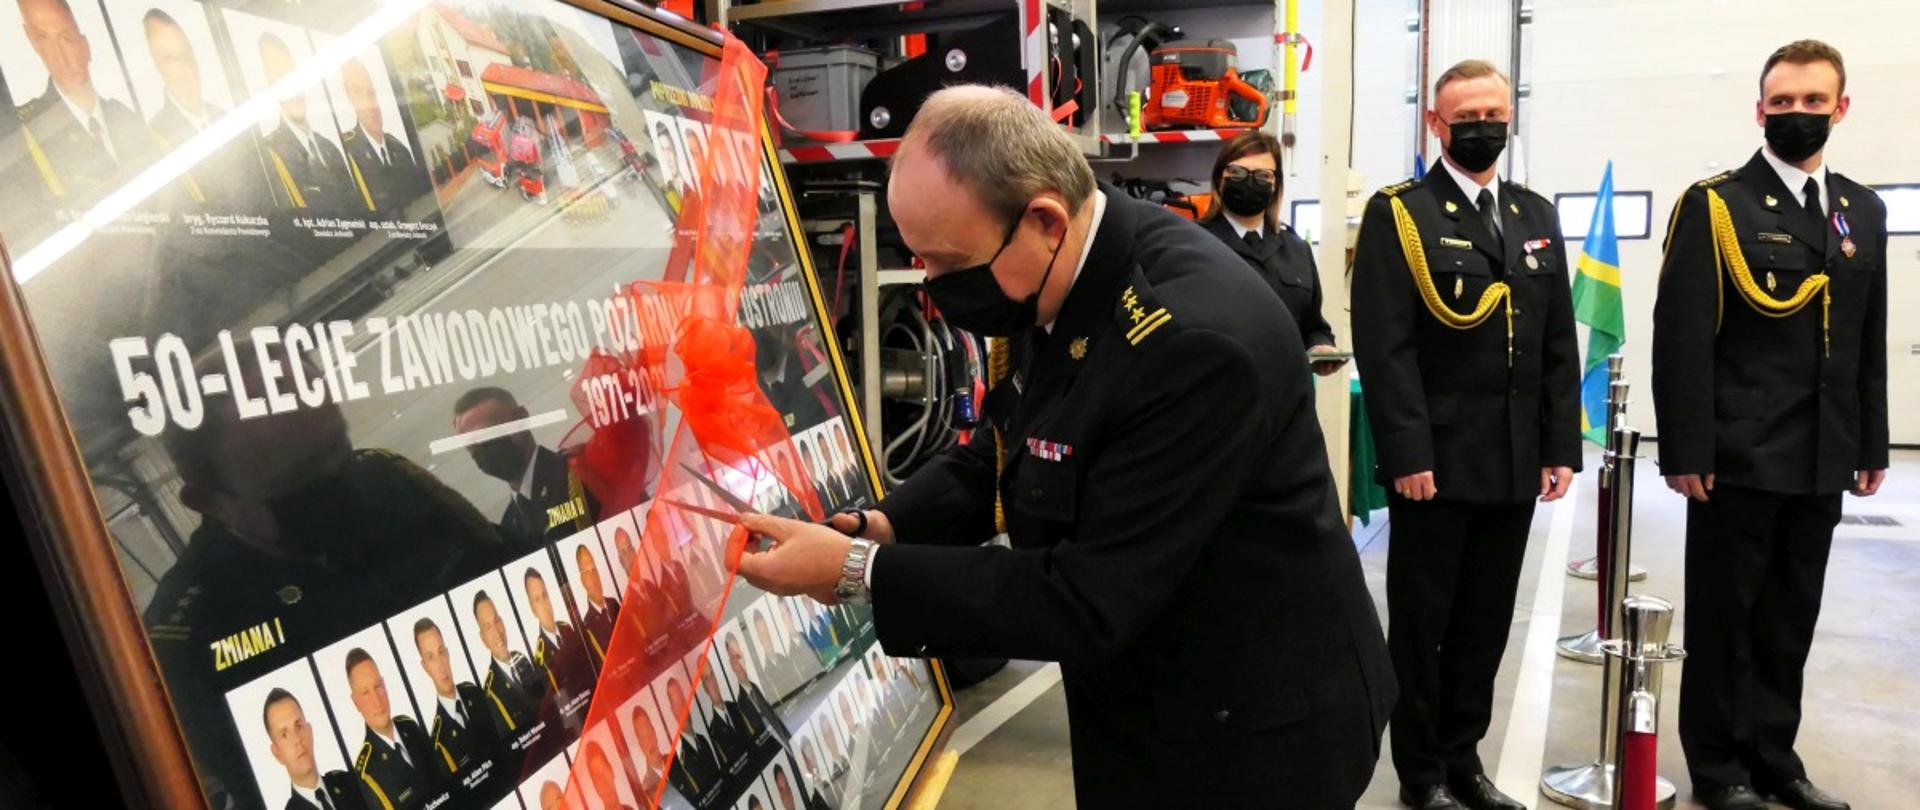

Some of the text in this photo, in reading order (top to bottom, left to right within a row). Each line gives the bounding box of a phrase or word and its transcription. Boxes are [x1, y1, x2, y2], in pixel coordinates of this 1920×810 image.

[109, 318, 369, 437] 50-LECIE
[367, 302, 592, 394] ZAWODOWEGO
[740, 281, 807, 330] USTRONIU
[210, 617, 286, 672] ZMIANA I
